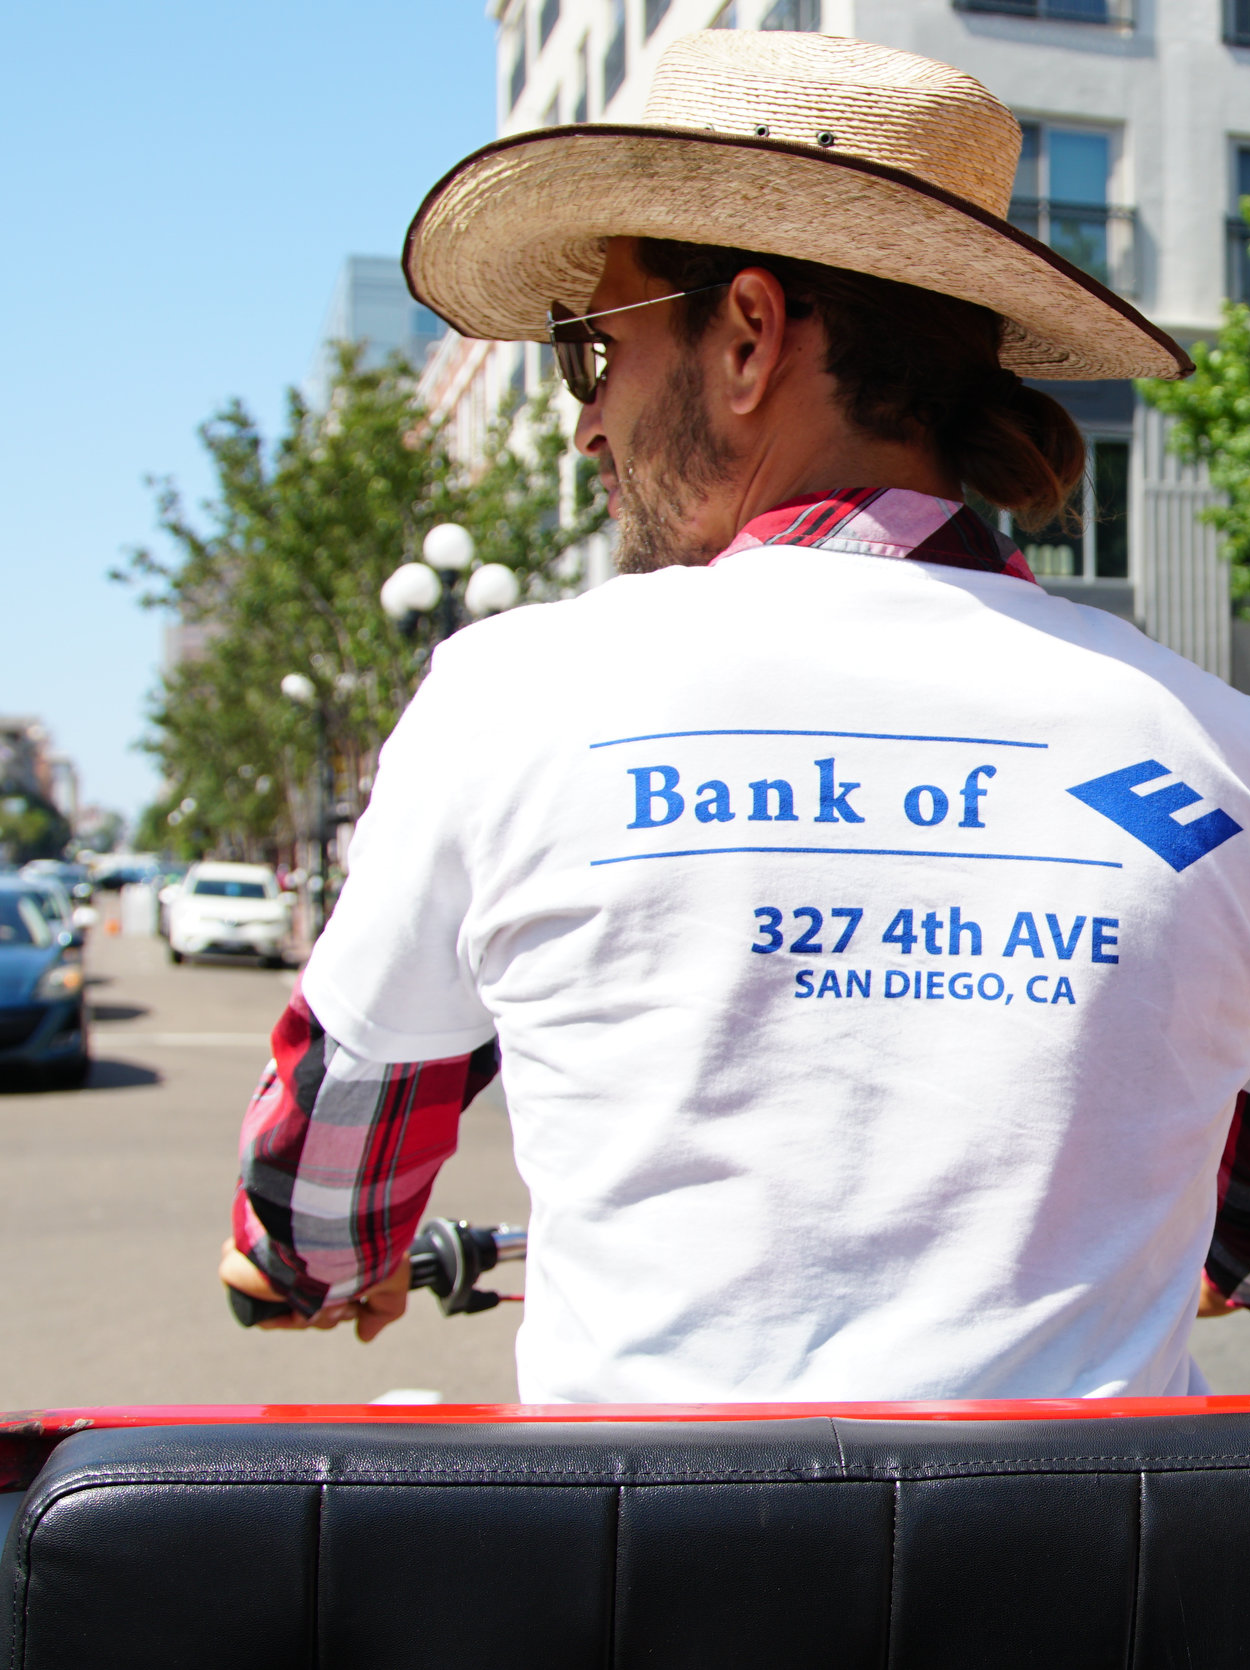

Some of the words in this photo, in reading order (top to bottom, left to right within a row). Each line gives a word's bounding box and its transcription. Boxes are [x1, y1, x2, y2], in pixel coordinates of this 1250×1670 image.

[626, 757, 865, 829] Bank
[903, 765, 997, 828] of
[751, 906, 863, 954] 327
[881, 906, 983, 956] 4th
[1002, 911, 1120, 964] AVE
[794, 968, 872, 999] SAN
[884, 970, 1015, 1006] DIEGO,
[1025, 975, 1077, 1005] CA
